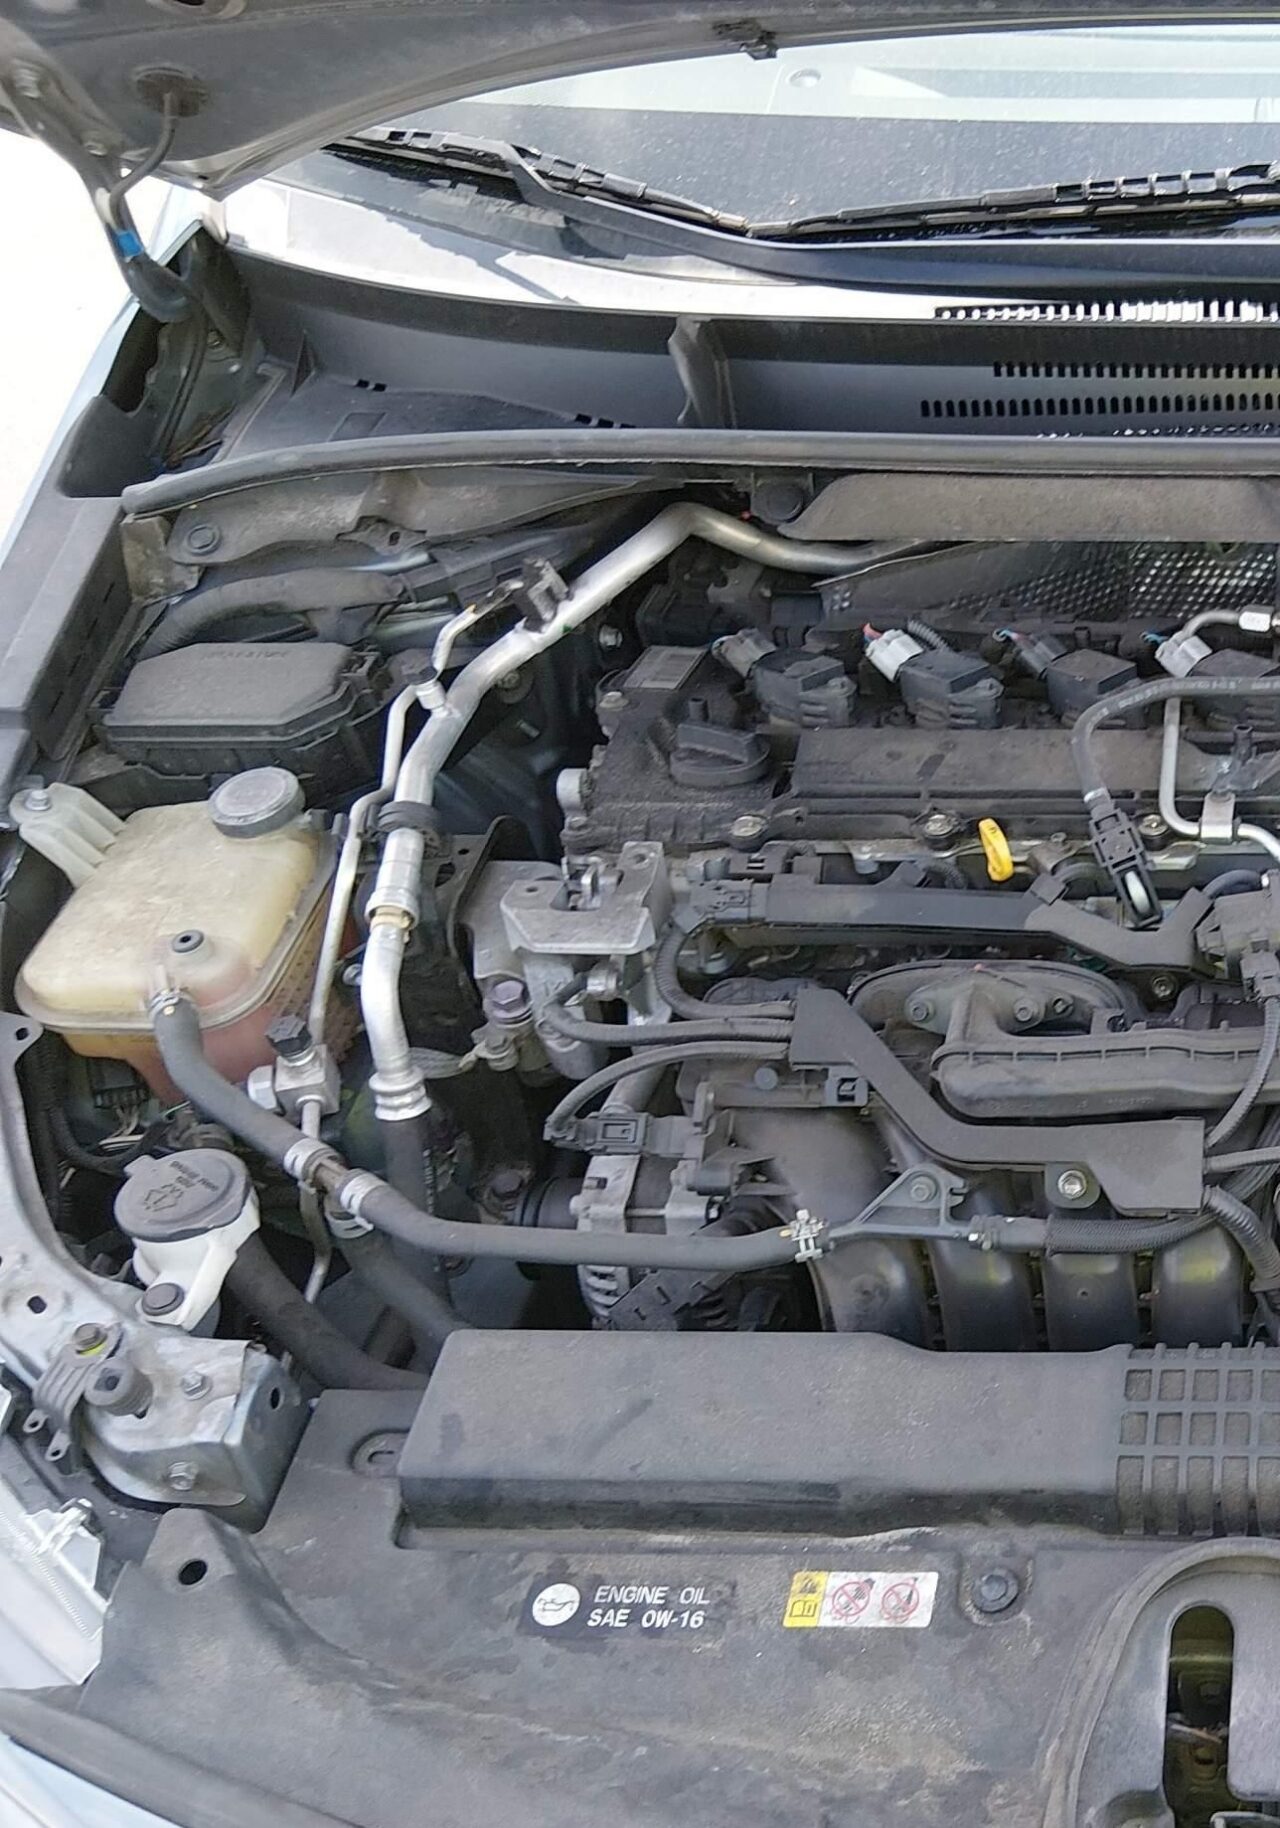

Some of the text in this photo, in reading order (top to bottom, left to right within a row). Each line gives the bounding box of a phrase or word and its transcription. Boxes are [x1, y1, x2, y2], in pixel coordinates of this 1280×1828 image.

[594, 1584, 710, 1605] ENGINE OIL
[587, 1608, 705, 1629] SAE 0W-16
